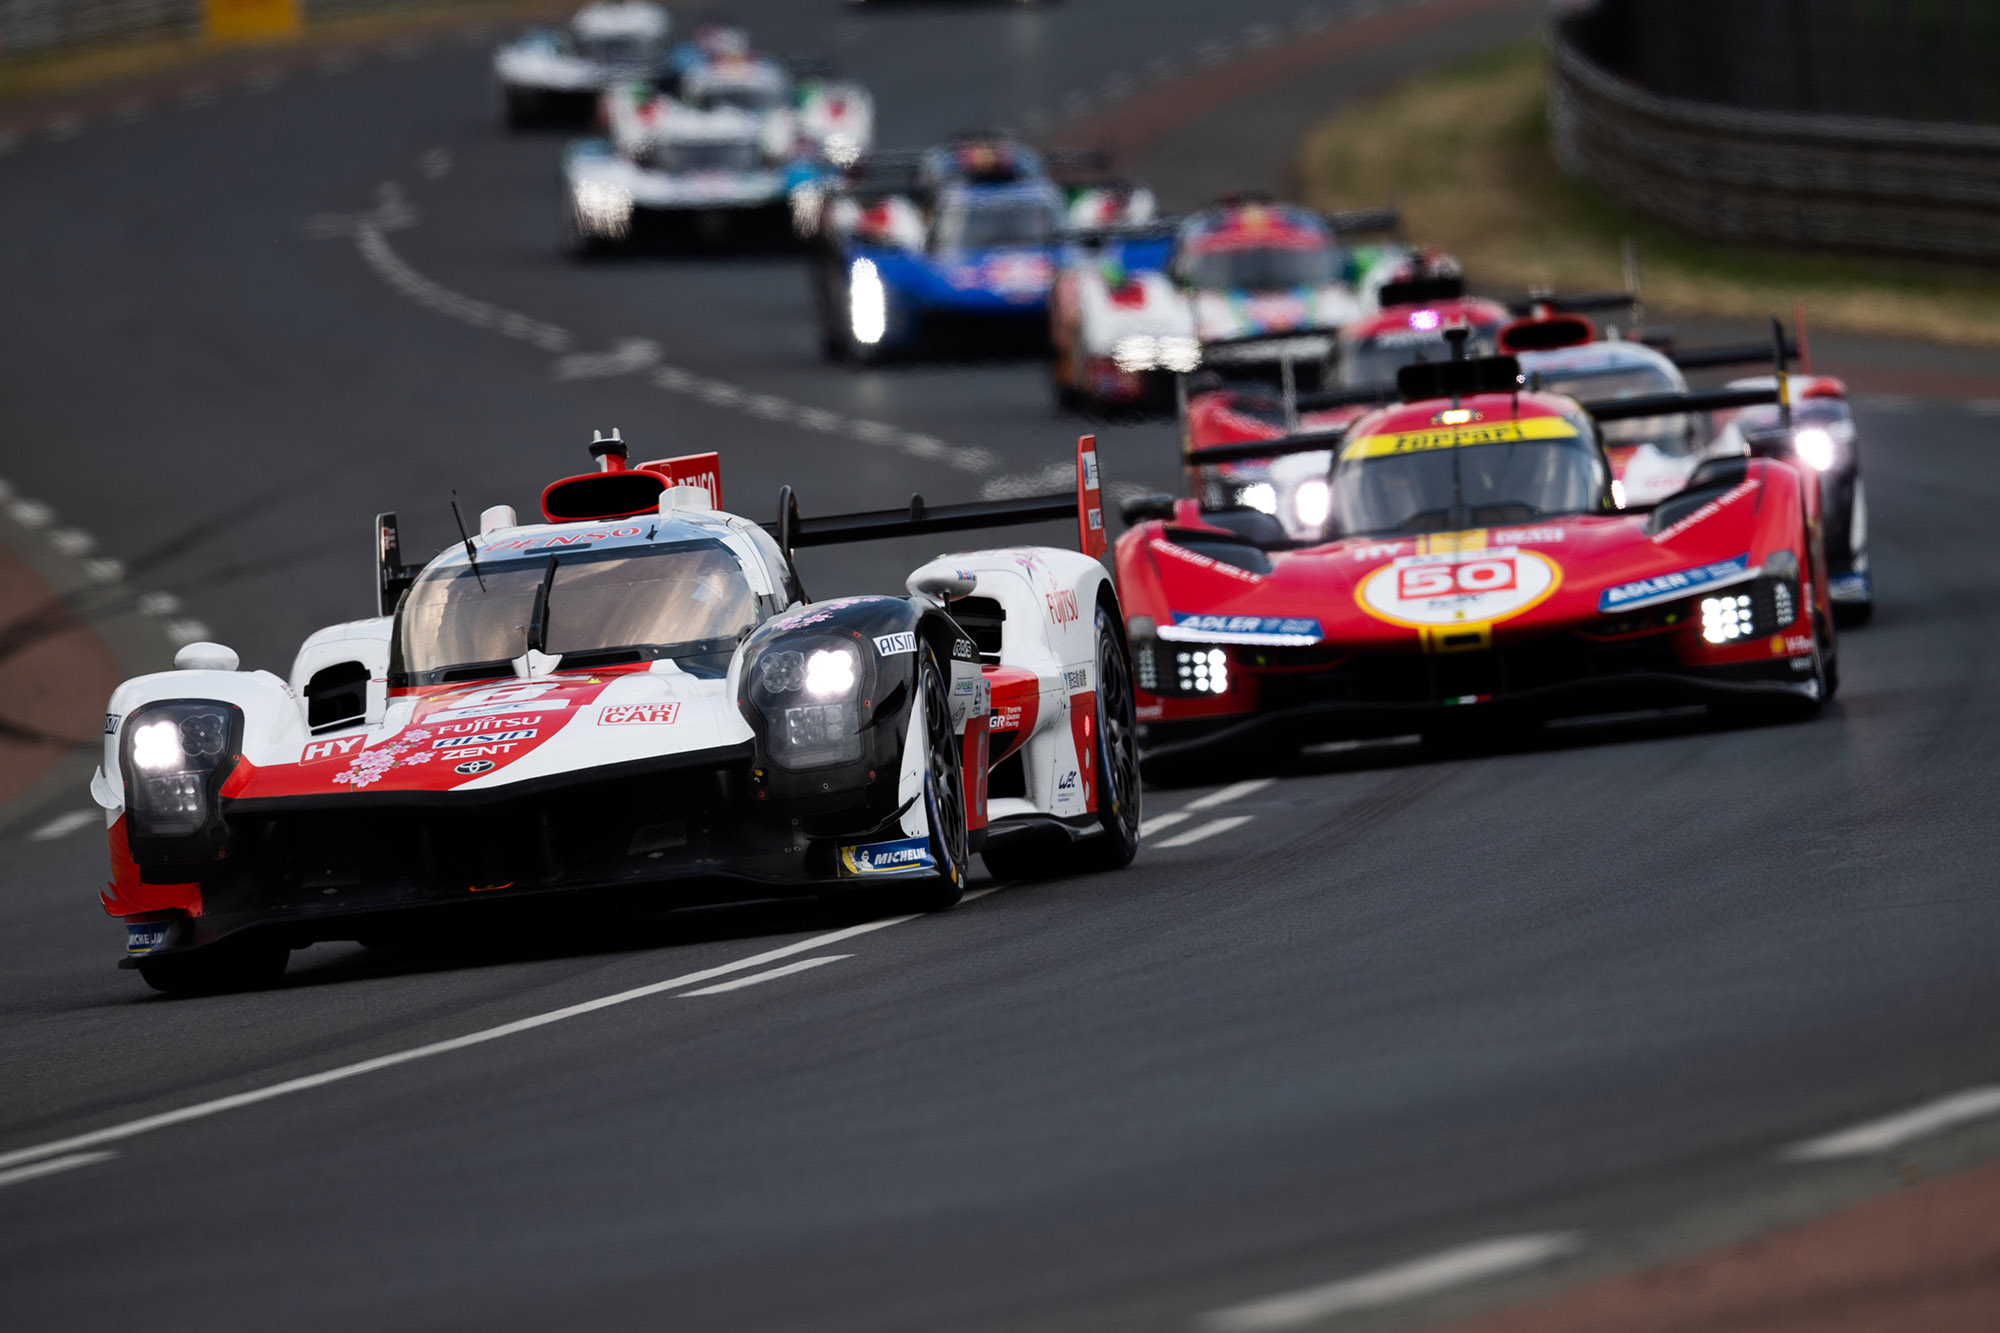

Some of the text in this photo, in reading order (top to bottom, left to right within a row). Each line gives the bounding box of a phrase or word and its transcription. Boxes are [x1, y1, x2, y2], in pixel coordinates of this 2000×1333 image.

[483, 527, 641, 551] DENSO
[1403, 561, 1512, 598] 50
[1608, 572, 1689, 602] ADLER
[1046, 589, 1079, 632] FUJITSU
[1178, 615, 1263, 633] ADLER
[880, 633, 915, 655] AISIN
[604, 711, 671, 723] CAR
[606, 704, 673, 713] HYPER
[438, 715, 542, 736] FUJITSU
[990, 715, 1005, 728] GR
[304, 736, 363, 760] HY
[435, 730, 534, 748] AISIN
[441, 743, 518, 760] ZENT
[874, 847, 927, 866] MICHELIN
